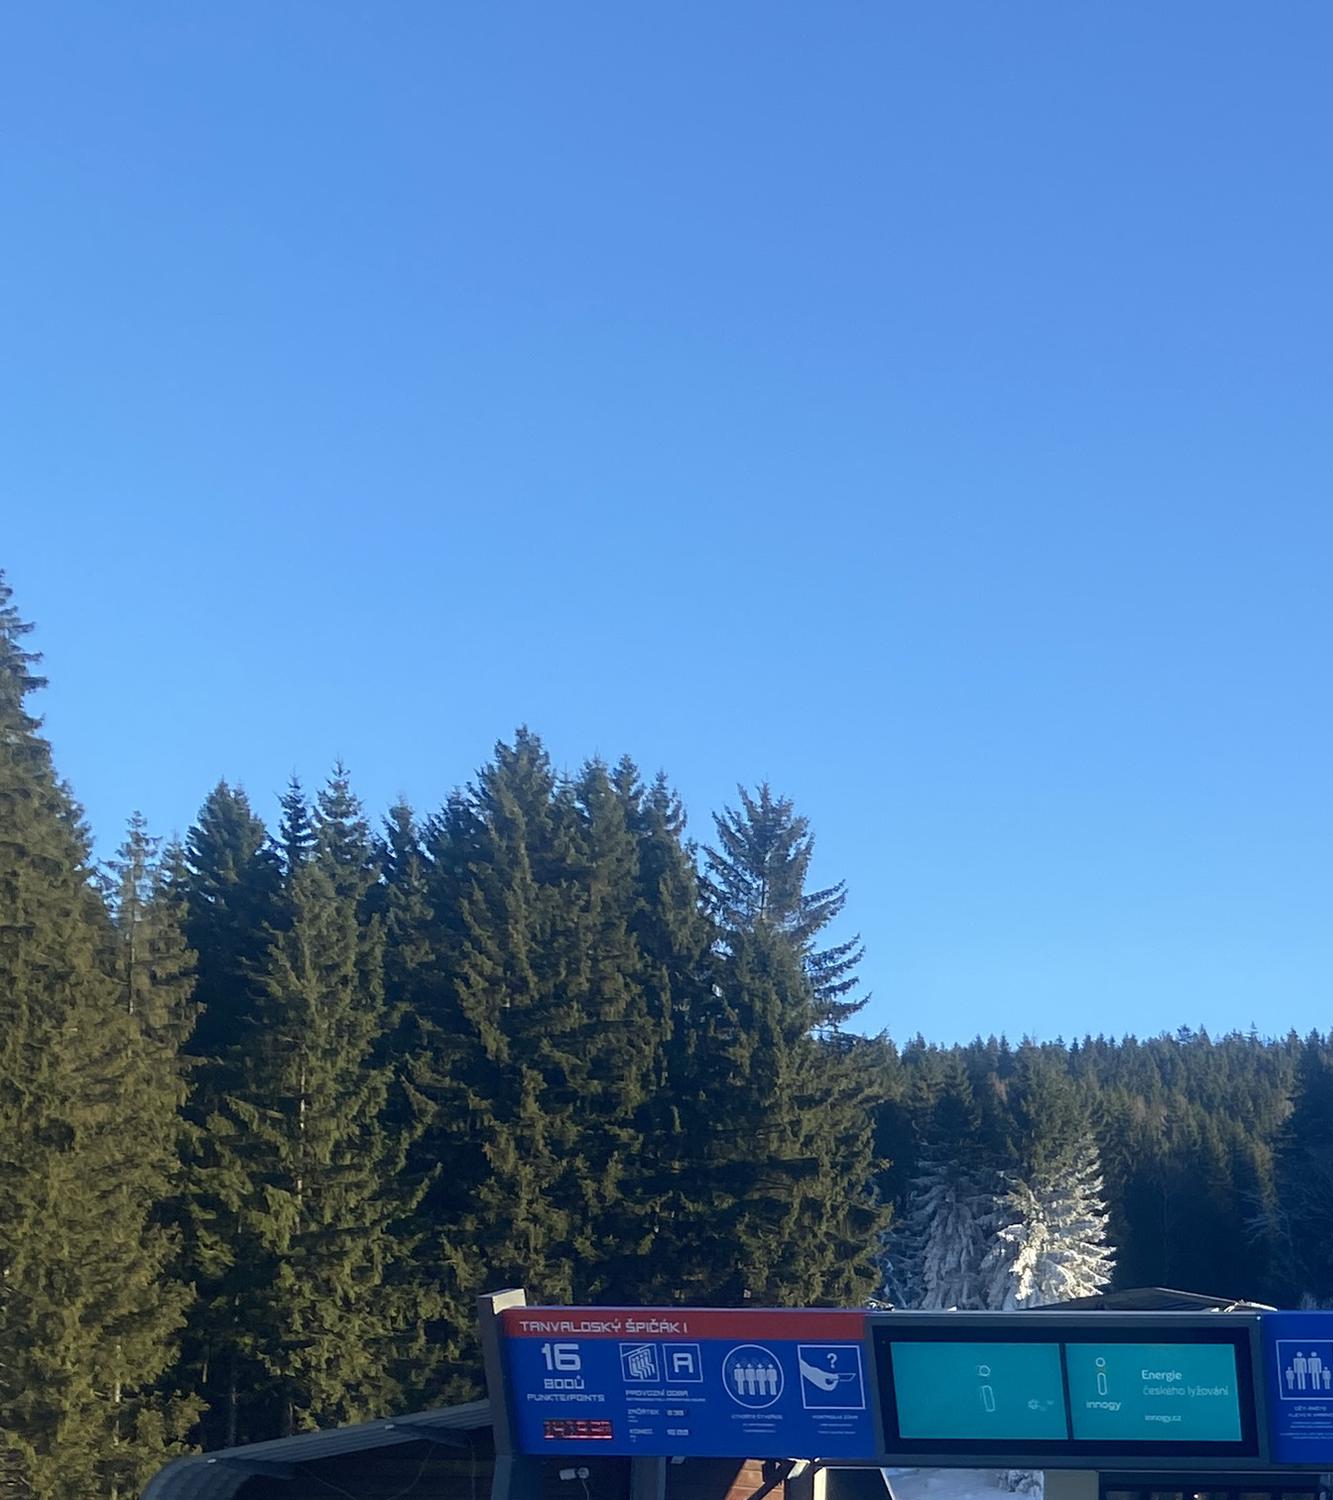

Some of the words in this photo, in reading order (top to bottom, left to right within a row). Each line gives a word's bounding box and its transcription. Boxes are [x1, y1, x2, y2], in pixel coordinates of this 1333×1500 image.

[625, 1318, 680, 1333] ŠPIČÁK
[541, 1342, 582, 1372] 16
[672, 1353, 694, 1374] A
[1141, 1369, 1183, 1382] Energie
[1086, 1401, 1122, 1411] innogy
